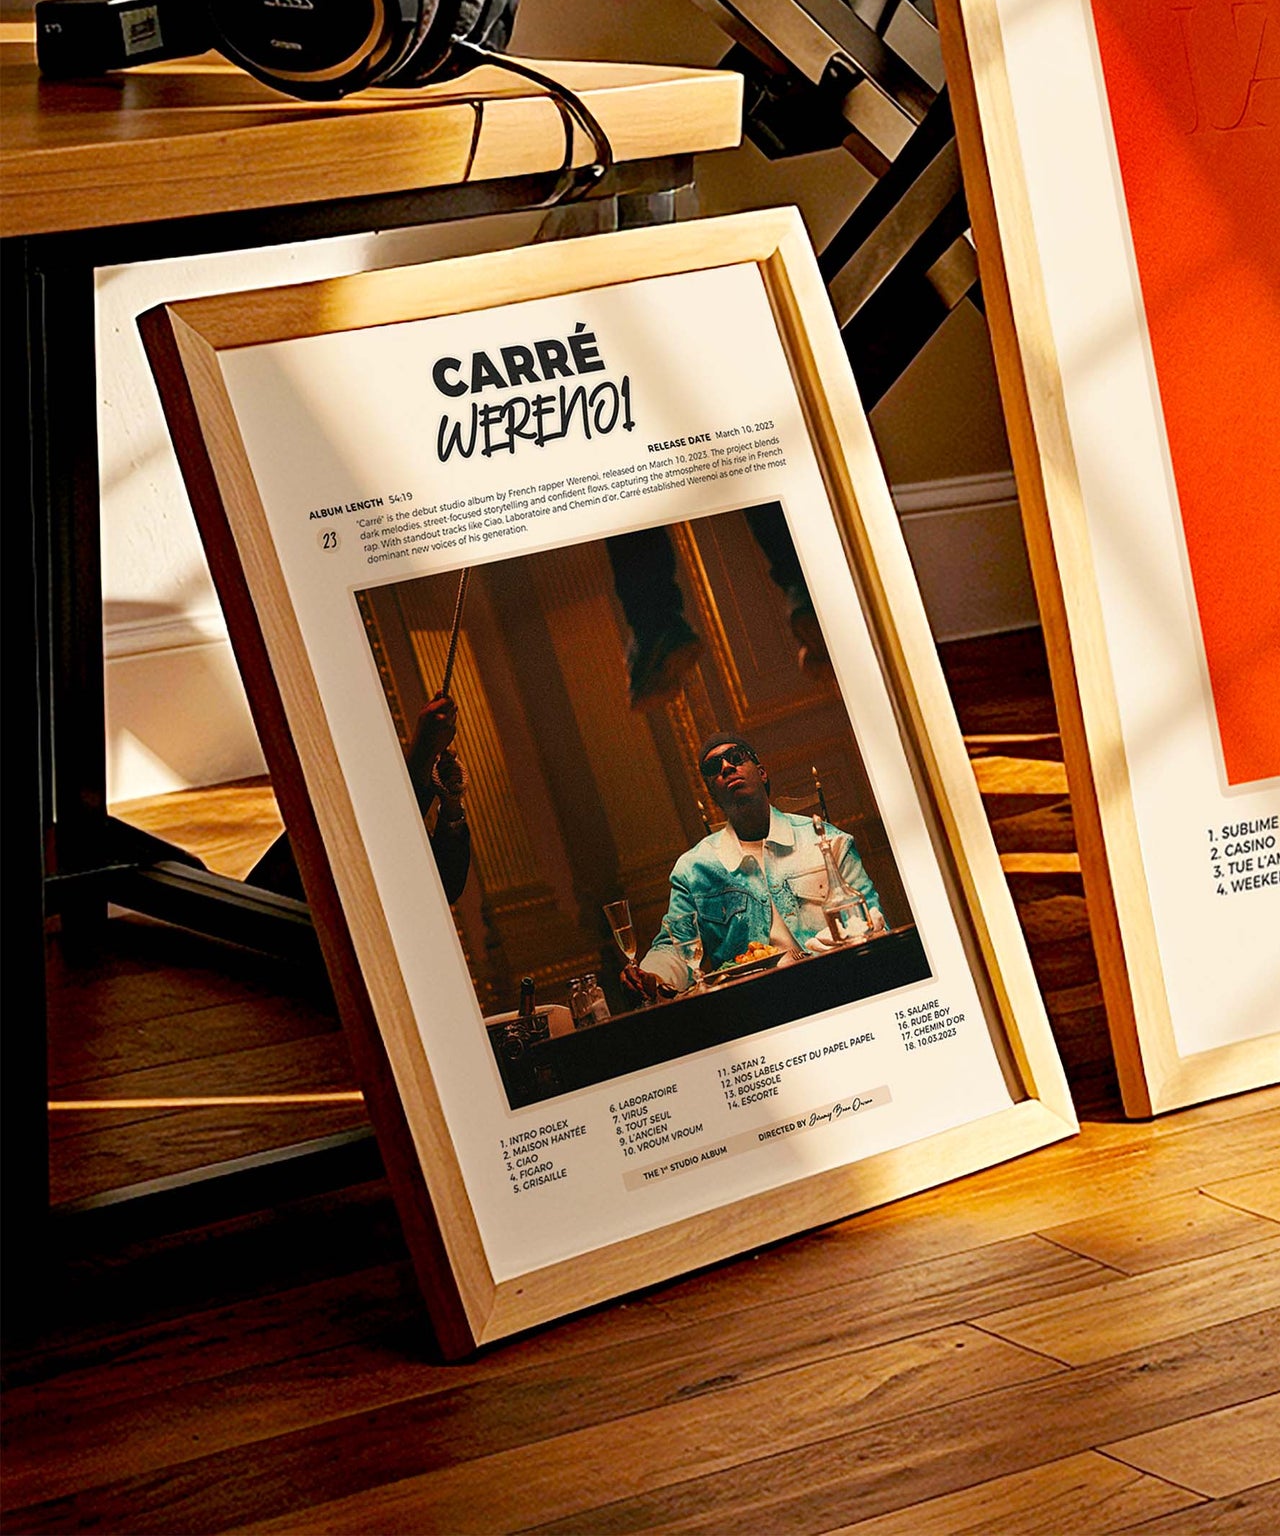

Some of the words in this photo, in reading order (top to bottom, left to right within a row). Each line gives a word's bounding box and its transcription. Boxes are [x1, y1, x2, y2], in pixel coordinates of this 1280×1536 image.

[433, 322, 605, 397] CARRÉ
[438, 376, 635, 462] WERENOI
[647, 437, 687, 453] RELEASE
[687, 432, 712, 445] DATE
[714, 427, 740, 439] March
[741, 425, 754, 433] 10,
[754, 420, 774, 431] 2023
[309, 505, 343, 520] ALBUM
[344, 497, 384, 513] LENGTH
[388, 491, 413, 504] 54:19
[323, 532, 336, 549] 23
[367, 548, 410, 564] dominant
[411, 545, 430, 555] new
[430, 539, 457, 551] voices
[457, 534, 467, 545] of
[468, 532, 481, 543] his
[1207, 829, 1218, 842] 1.
[1221, 815, 1279, 840] SUBLIME
[1210, 847, 1221, 861] 2.
[1224, 835, 1276, 857] CASINO
[1213, 864, 1225, 879] 3.
[1227, 857, 1253, 875] TUE
[1216, 883, 1228, 895] 4.
[904, 1041, 916, 1051] 18.
[917, 1027, 957, 1047] 10.03.2023
[499, 1139, 508, 1148] 1.
[509, 1129, 538, 1146] INTRO
[538, 1119, 569, 1136] ROLEX
[502, 1150, 511, 1160] 2.
[512, 1137, 549, 1157] MAISON
[550, 1125, 587, 1144] HANTÉE
[506, 1161, 515, 1171] 3.
[515, 1153, 539, 1168] CIAO
[509, 1173, 518, 1181] 4.
[519, 1161, 553, 1179] FIGARO
[513, 1184, 521, 1194] 5.
[522, 1168, 567, 1190] GRISAILLE
